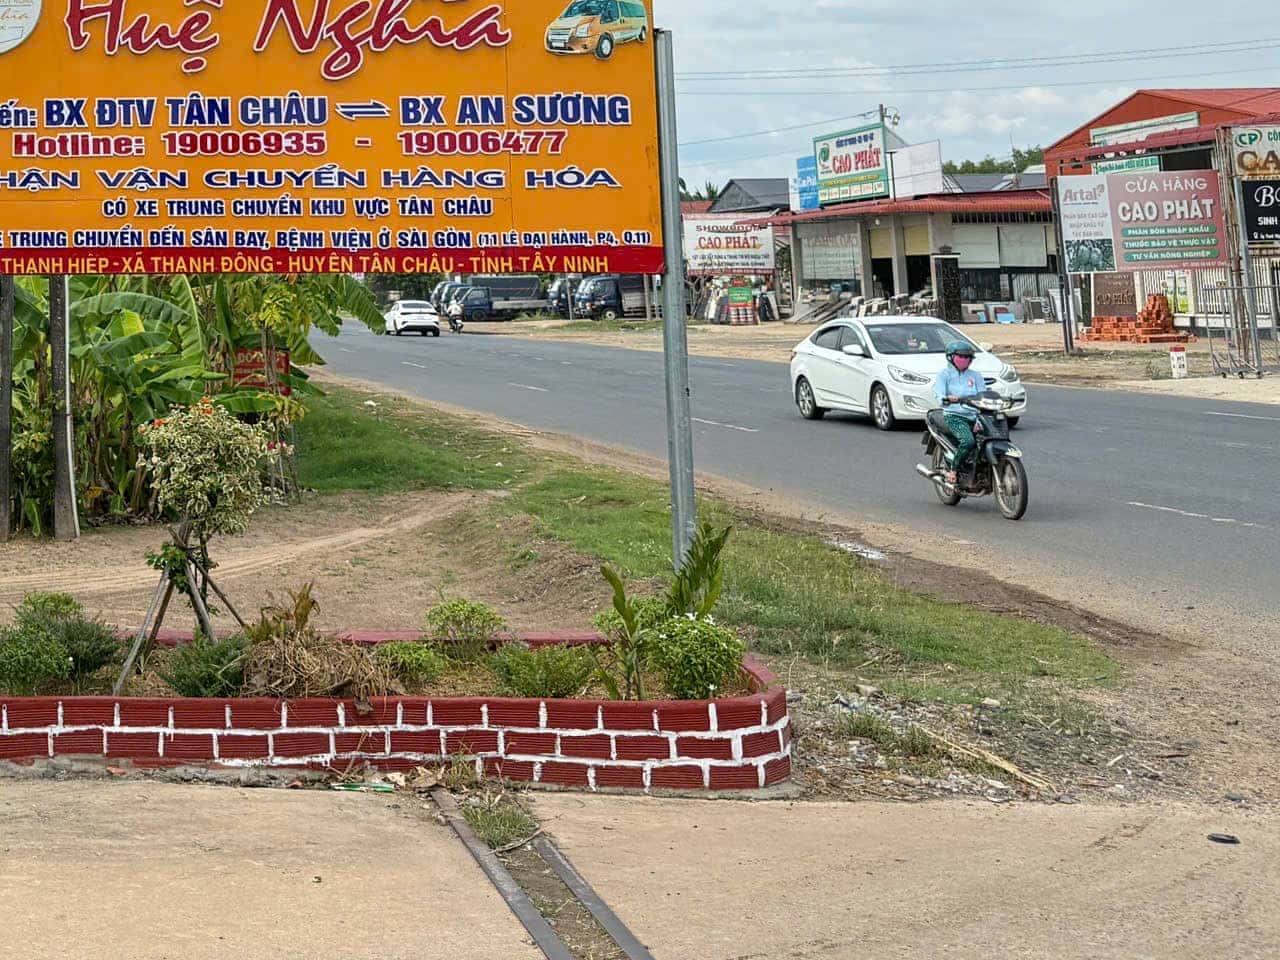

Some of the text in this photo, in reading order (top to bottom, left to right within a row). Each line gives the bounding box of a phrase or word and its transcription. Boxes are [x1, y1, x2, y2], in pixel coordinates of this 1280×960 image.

[44, 98, 88, 128] BX
[95, 98, 156, 127] ĐTV
[166, 92, 230, 126] TÂN
[239, 91, 328, 125] CHÂU
[400, 96, 445, 125] BX
[456, 96, 505, 125] AN
[513, 94, 631, 125] SƯƠNG
[12, 132, 145, 157] Hotline:
[161, 131, 327, 156] 19006935
[397, 130, 568, 155] 19006477
[1238, 133, 1258, 145] CP
[832, 153, 852, 174] CAO
[853, 143, 881, 171] PHÁT
[95, 167, 188, 191] VẬN
[204, 163, 367, 188] CHUYỂN
[381, 166, 505, 189] HÀNG
[524, 165, 622, 188] HÓA
[1125, 175, 1208, 194] CỬA HÀNG
[102, 192, 493, 219] CÓ XE TRUNG CHUYỂN KHU VỰC TÂN CHÂU
[1064, 187, 1098, 202] Artal
[1118, 194, 1214, 221] CAO PHÁT
[9, 230, 68, 248] TRUNG
[73, 224, 143, 248] CHUYỂN
[191, 227, 228, 248] SÂN
[234, 230, 270, 249] BAY,
[276, 227, 325, 252] BỆNH
[330, 227, 373, 252] VIỆN
[378, 227, 392, 249] Ở
[397, 227, 428, 248] SÀI
[433, 227, 472, 249] GÒN
[502, 230, 518, 246] LÊ
[698, 232, 759, 249] CAO PHÁT
[122, 252, 146, 273] XÃ
[220, 251, 274, 272] ĐÔNG
[359, 252, 396, 272] TÂN
[402, 253, 454, 273] CHÂU
[470, 250, 512, 273] TỈNH
[519, 252, 557, 272] TÂY
[563, 255, 609, 272] NINH
